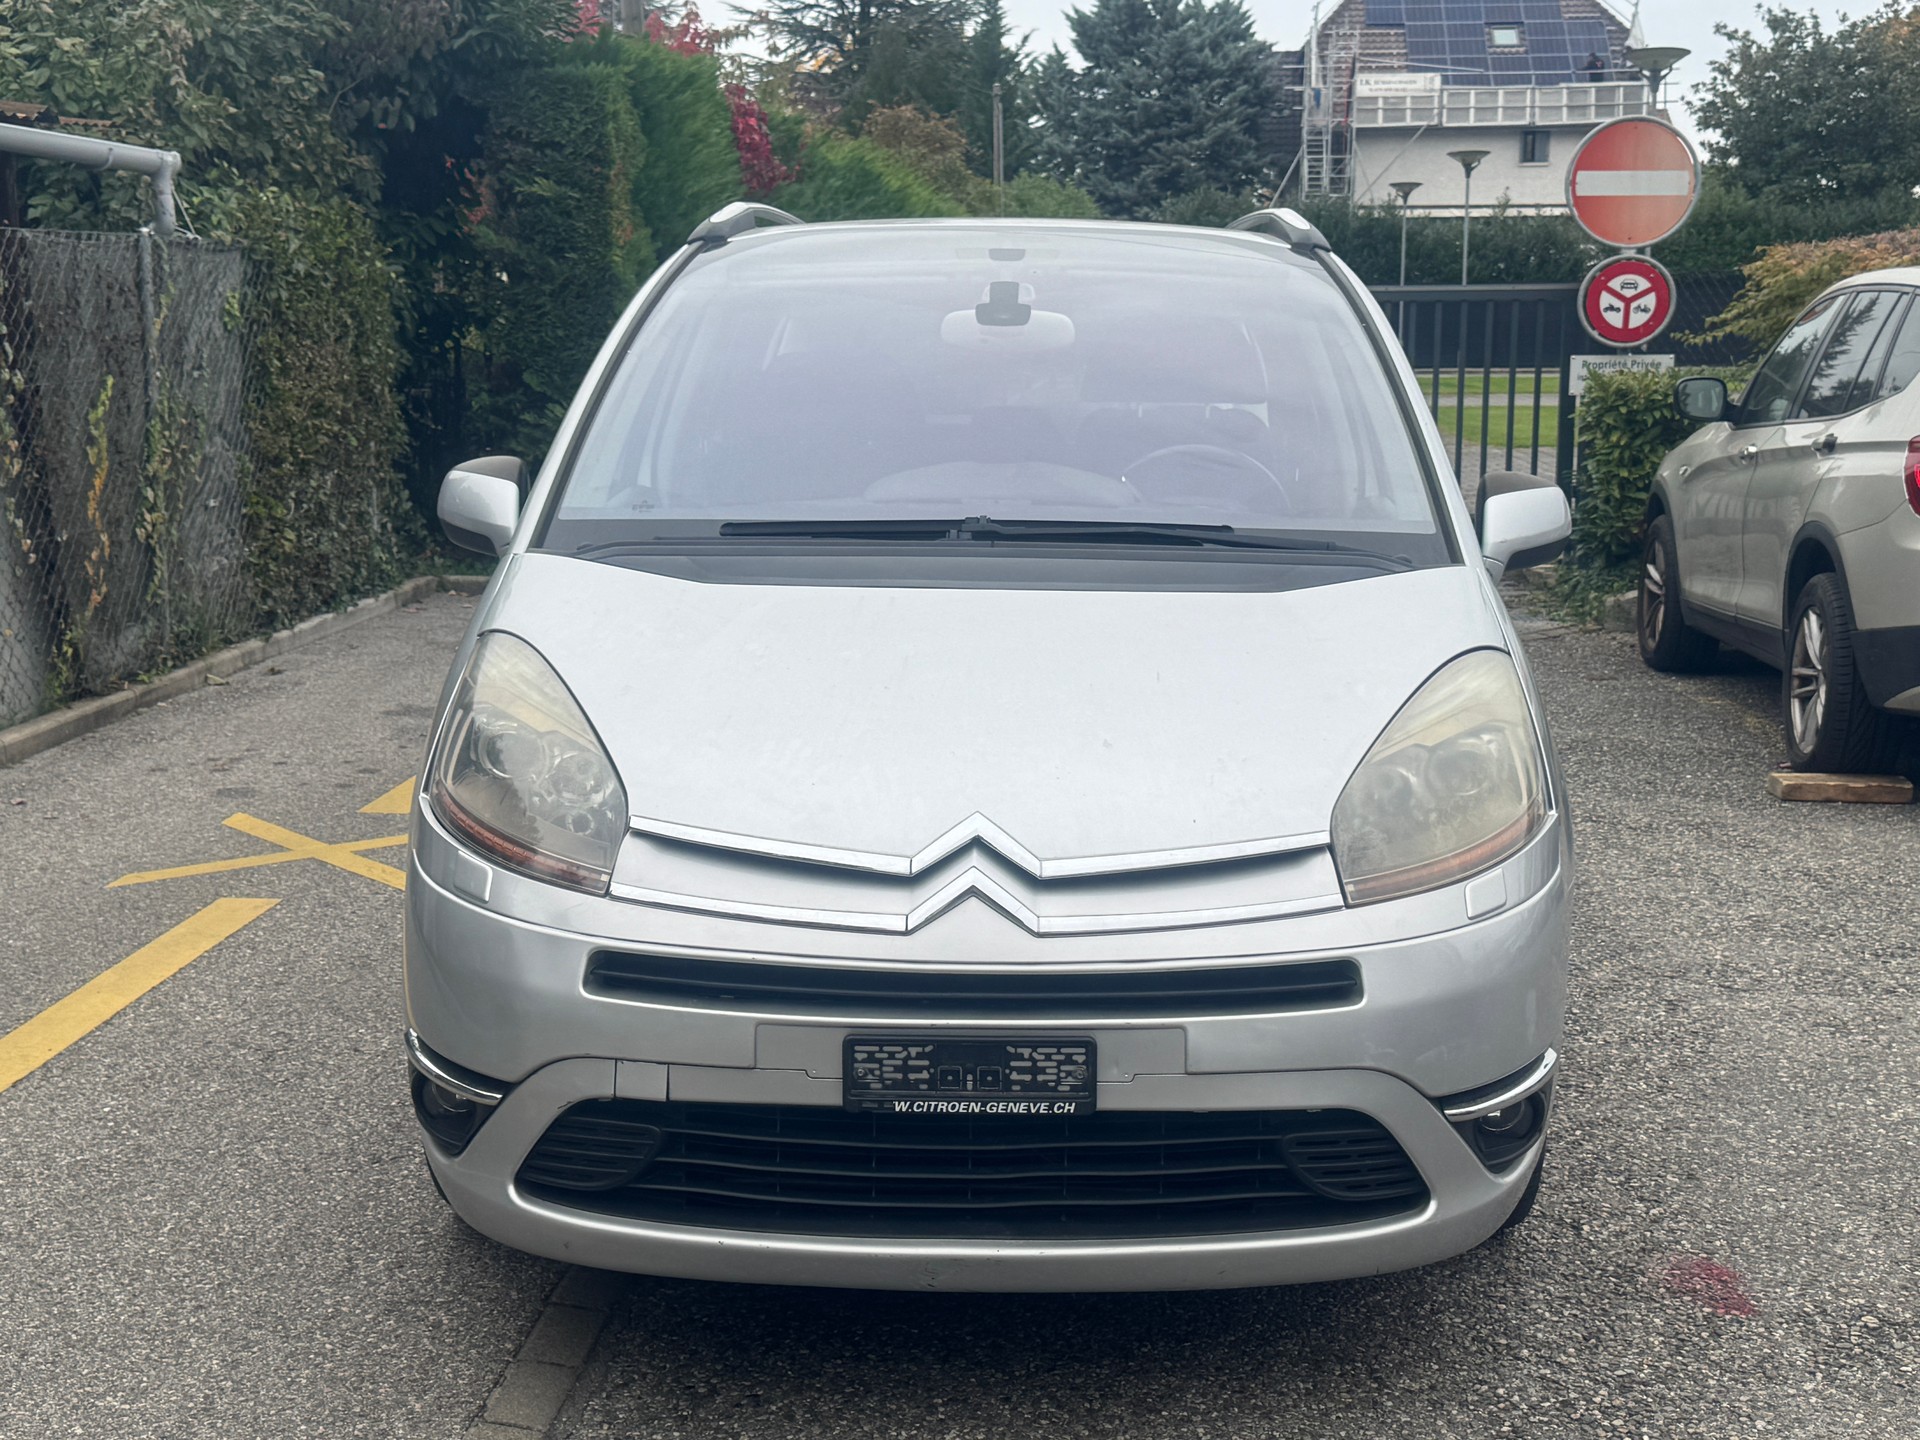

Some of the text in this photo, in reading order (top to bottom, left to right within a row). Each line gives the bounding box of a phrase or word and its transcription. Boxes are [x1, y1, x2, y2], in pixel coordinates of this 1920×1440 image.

[1581, 359, 1662, 371] Propriété Privée
[893, 1100, 1076, 1114] W.CITROEN-GENEVE.CH
